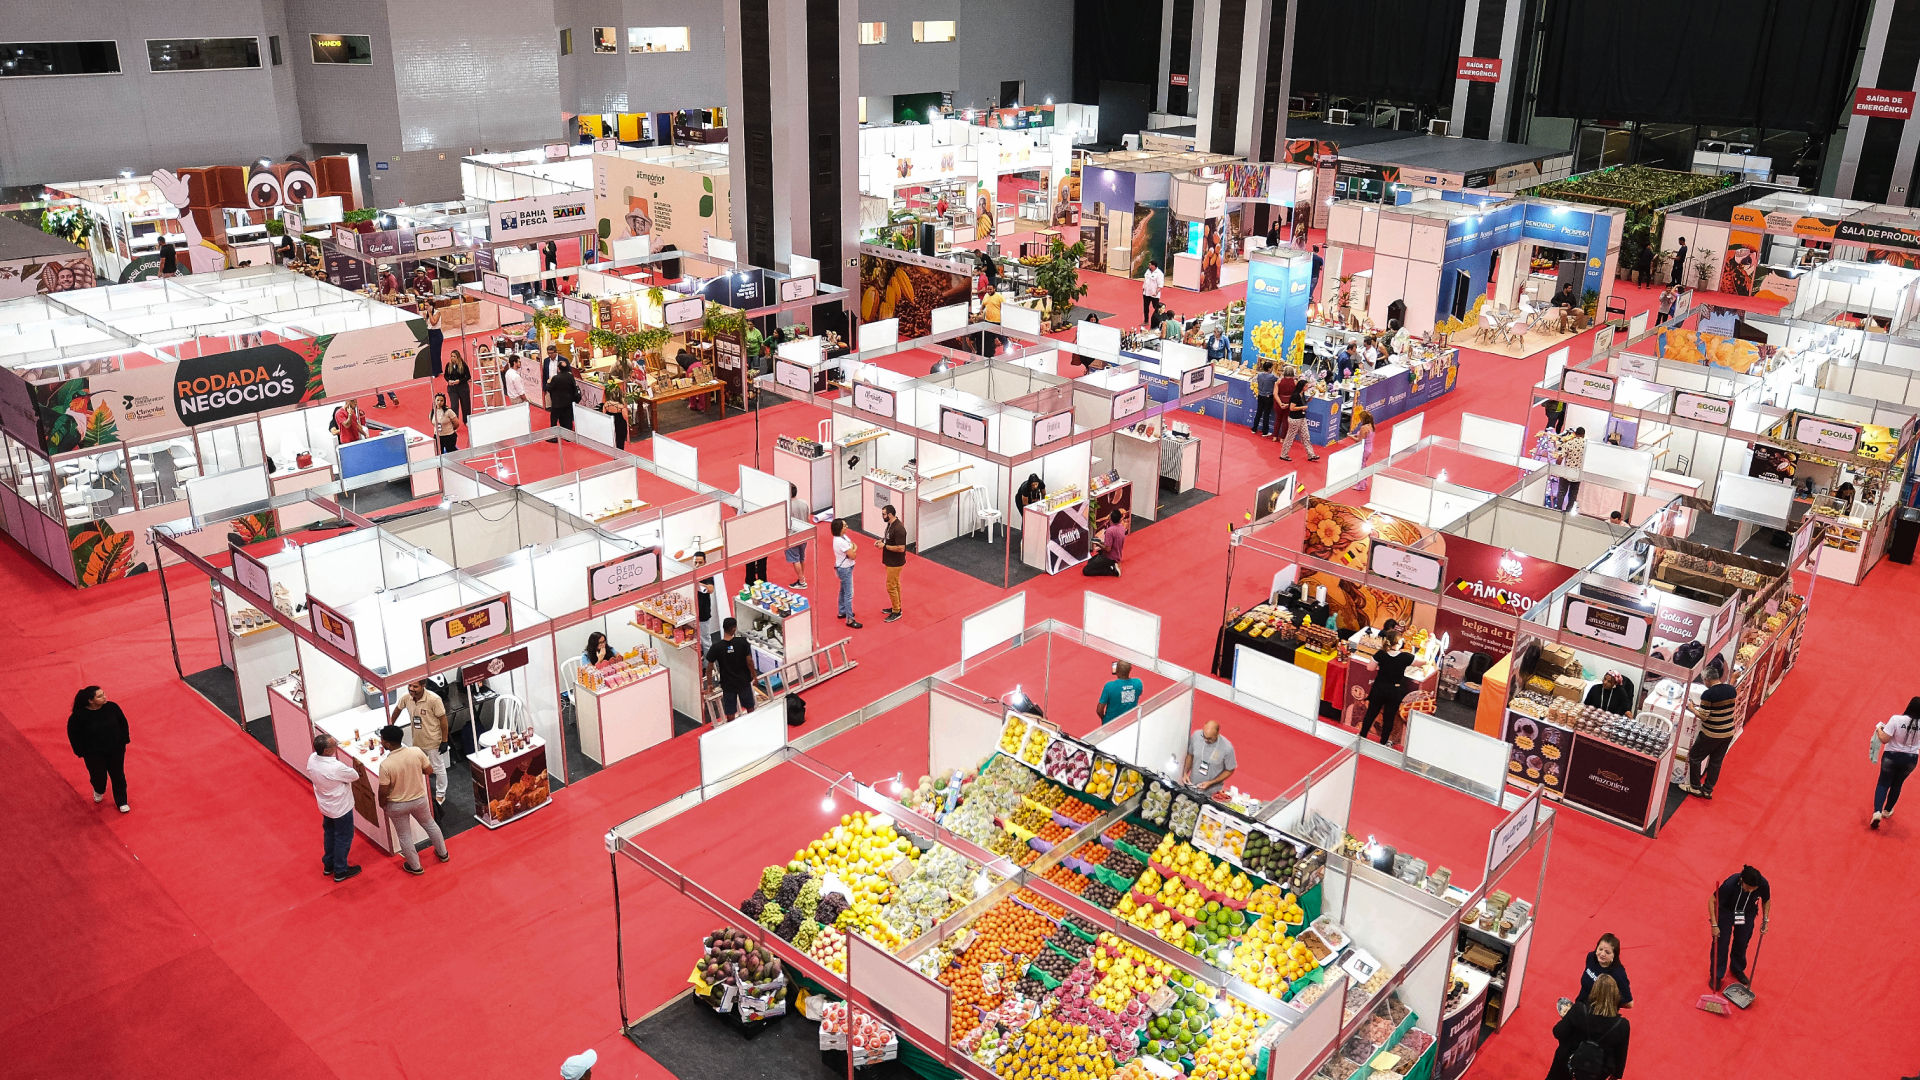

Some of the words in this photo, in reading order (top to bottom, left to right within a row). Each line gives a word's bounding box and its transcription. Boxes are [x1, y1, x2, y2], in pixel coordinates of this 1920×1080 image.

[1459, 69, 1498, 78] EMERGÊNCIA
[1866, 95, 1889, 103] SAÍDA
[1856, 103, 1908, 114] EMERGÊNCIA
[520, 209, 546, 219] BAHIA
[553, 206, 586, 219] BAHIA
[1733, 213, 1755, 222] CAEX
[520, 218, 548, 227] PESCA
[1525, 219, 1556, 228] RENOVADF
[1561, 226, 1590, 237] PROSPERA
[1796, 224, 1831, 233] INFORMAÇÕES
[1841, 225, 1865, 236] SALA
[1867, 229, 1880, 238] DE
[140, 261, 160, 271] ORIGE
[1266, 285, 1280, 293] GDF
[177, 366, 270, 398] RODADA
[272, 364, 288, 377] de
[1139, 374, 1169, 386] UALIFICADF
[1589, 380, 1611, 391] GOIÁS
[180, 378, 295, 415] NEGÓCIOS
[1210, 394, 1243, 405] ENOVADF
[1702, 403, 1727, 414] GOIÁS
[1306, 420, 1320, 428] GDF
[1826, 430, 1853, 441] GOIÁS
[616, 563, 635, 576] BEM
[608, 566, 643, 585] CACAO
[1466, 580, 1539, 613] ÂMCISO
[1660, 609, 1682, 623] Gota
[1682, 614, 1694, 627] de
[1462, 618, 1489, 634] belga
[1491, 625, 1504, 638] de
[1505, 630, 1516, 642] Li
[1658, 622, 1693, 638] cupuaçu
[1461, 630, 1482, 642] Tradição
[1487, 637, 1500, 647] sabor
